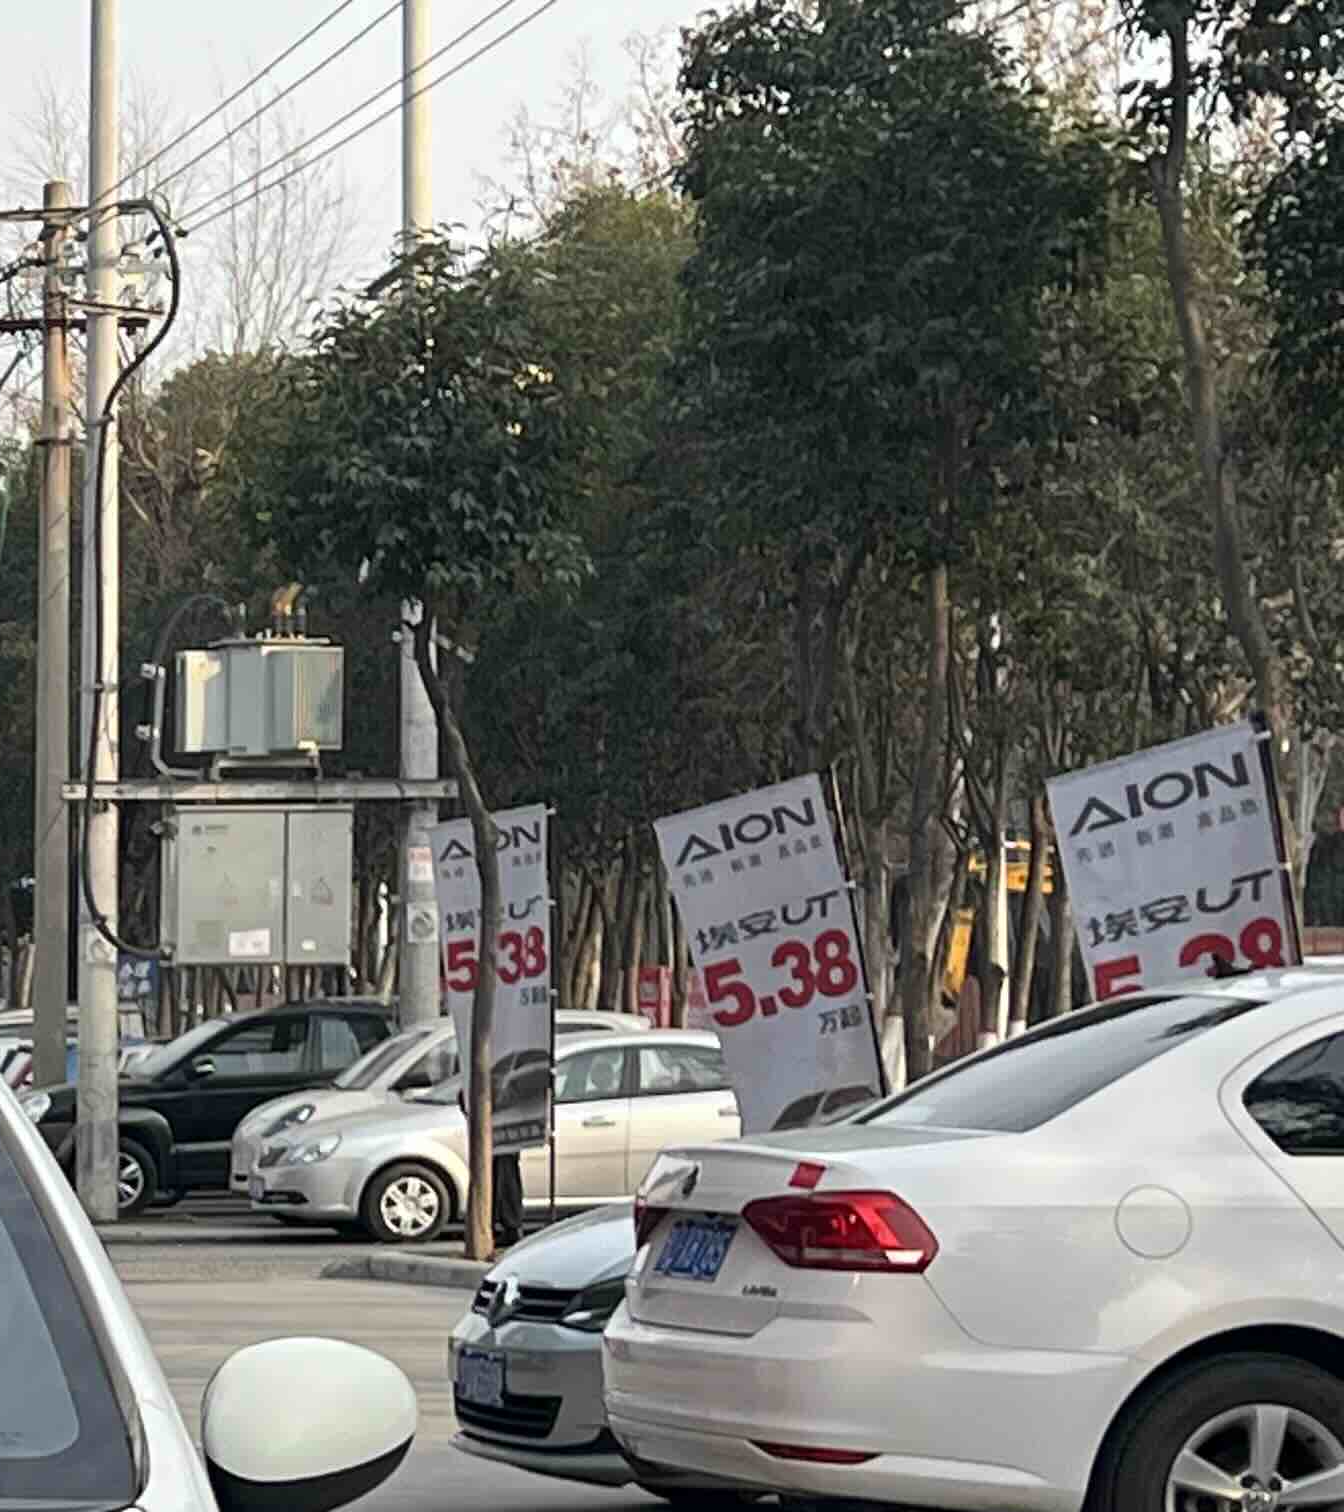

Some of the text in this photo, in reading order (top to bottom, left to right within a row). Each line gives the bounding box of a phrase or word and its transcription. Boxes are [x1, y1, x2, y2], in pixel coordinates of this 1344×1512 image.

[676, 798, 817, 867] AION
[1069, 751, 1250, 838] AION
[695, 889, 840, 955] 埃安UT
[1087, 868, 1273, 949] 埃安UT
[703, 928, 858, 1028] 5.38
